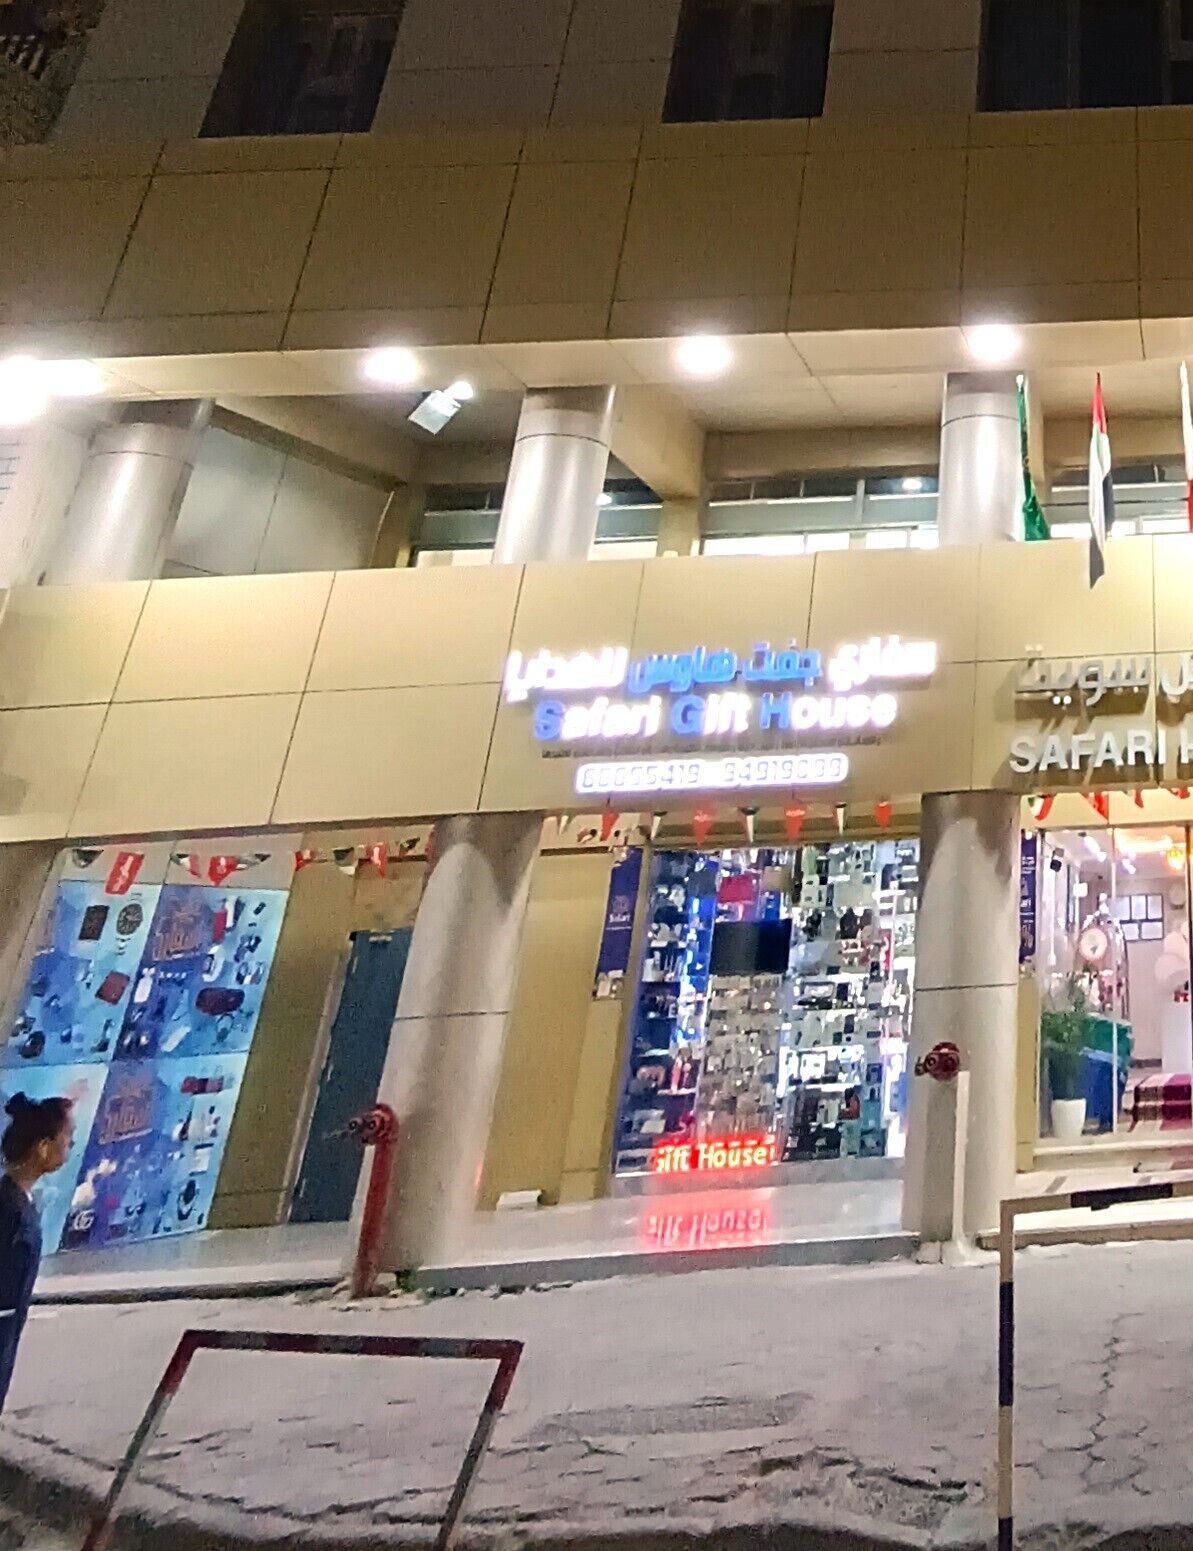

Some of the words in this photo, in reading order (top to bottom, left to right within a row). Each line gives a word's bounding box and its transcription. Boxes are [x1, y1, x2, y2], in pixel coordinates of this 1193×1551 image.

[1015, 644, 1150, 706] سويت
[533, 695, 662, 740] Safari
[670, 692, 752, 736] Gift
[760, 692, 897, 731] House
[1009, 728, 1167, 774] SAFARI
[696, 1141, 767, 1170] House
